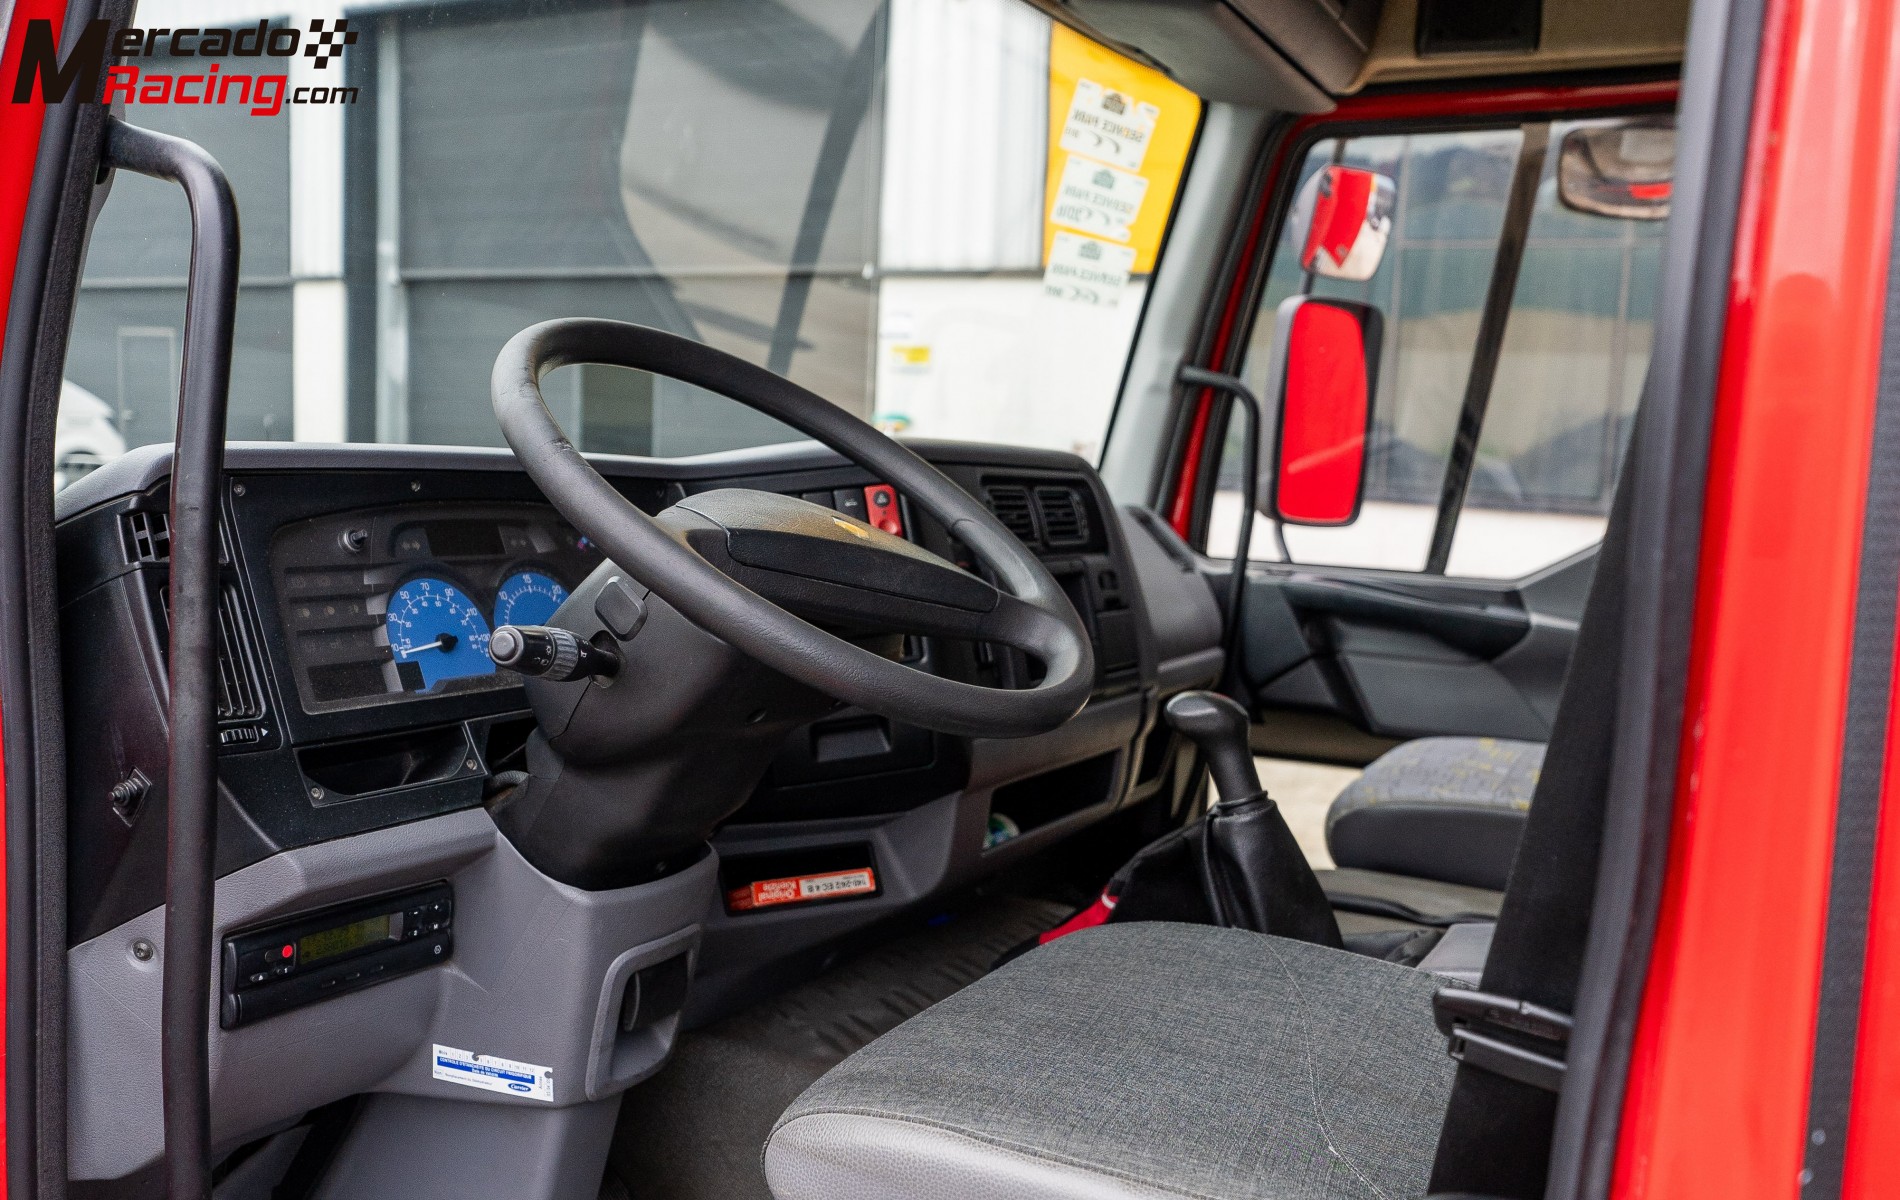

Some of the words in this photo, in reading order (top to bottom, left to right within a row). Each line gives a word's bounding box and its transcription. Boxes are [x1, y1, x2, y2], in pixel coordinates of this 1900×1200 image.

[522, 574, 532, 584] 15
[420, 582, 430, 590] 70
[399, 590, 410, 599] 50
[444, 588, 454, 596] 90
[499, 591, 508, 600] 10
[466, 608, 478, 616] 110
[388, 613, 397, 621] 30
[391, 643, 399, 652] 10
